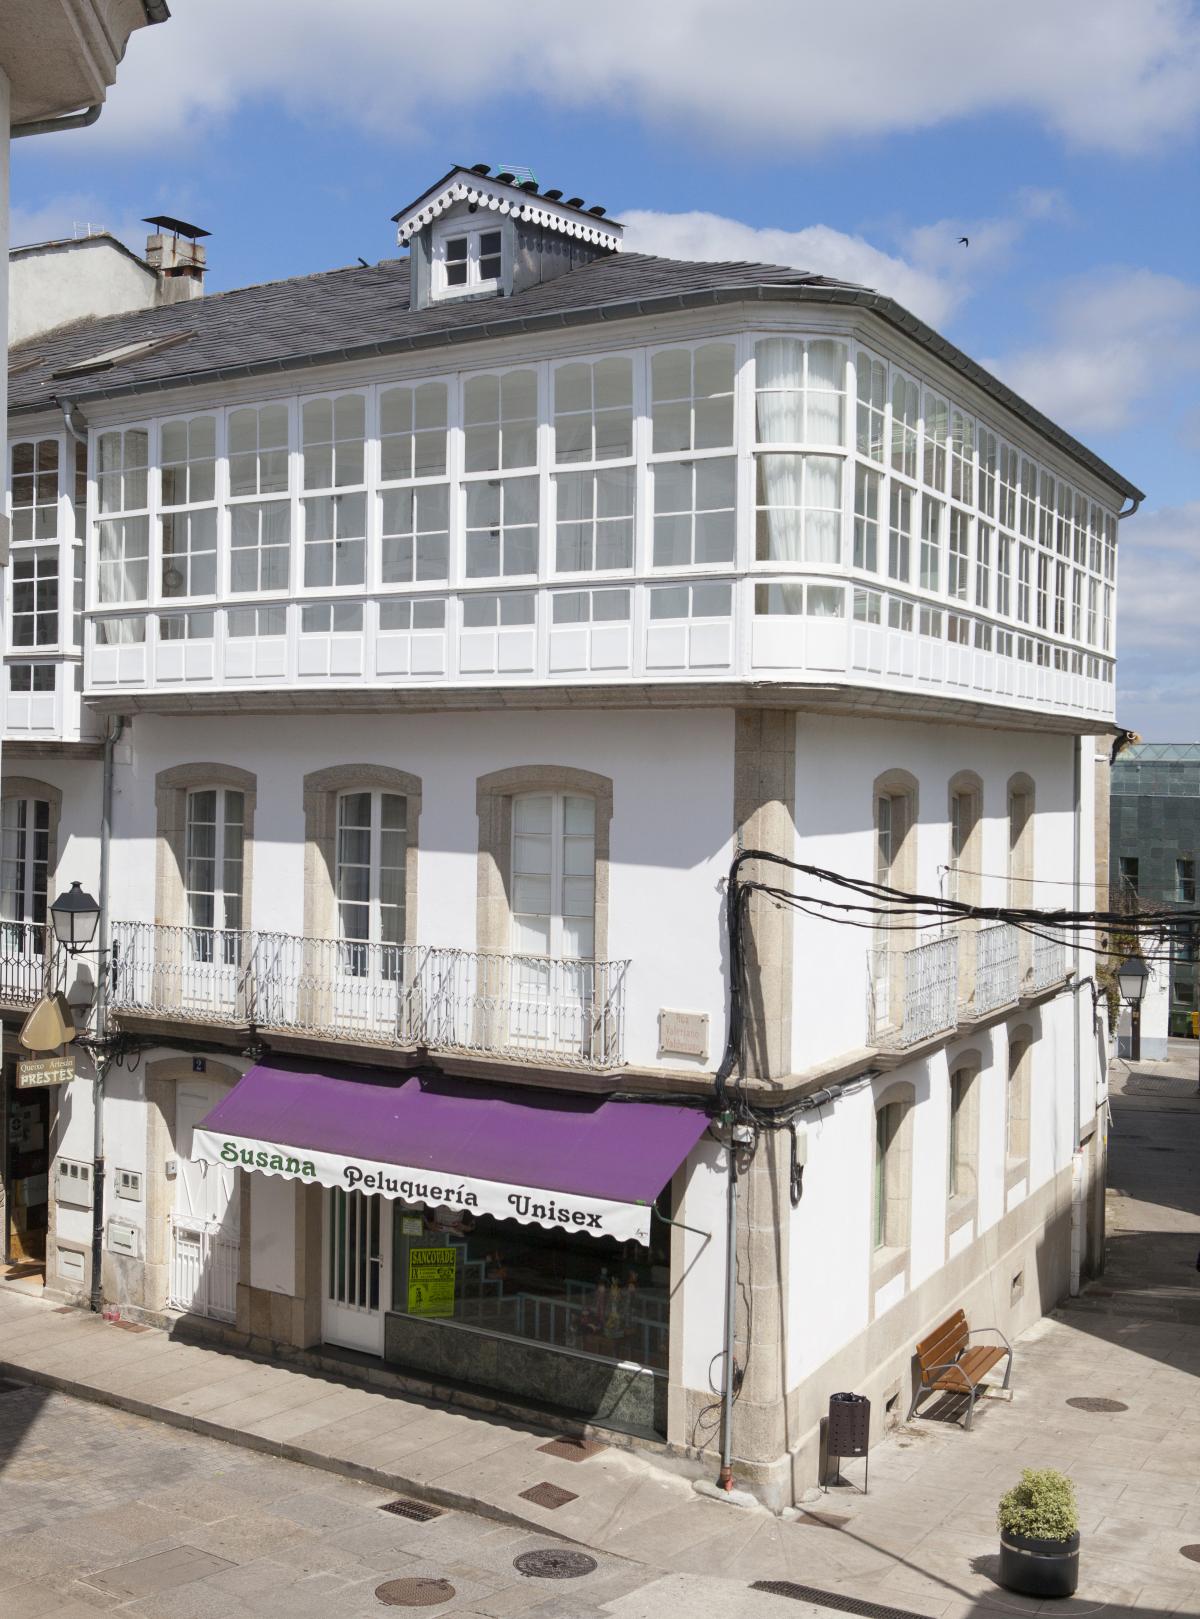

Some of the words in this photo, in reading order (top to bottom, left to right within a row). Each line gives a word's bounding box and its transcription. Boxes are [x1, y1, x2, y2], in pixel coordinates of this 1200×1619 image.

[21, 1063, 45, 1072] Queixo
[21, 1068, 74, 1086] PRESTES
[220, 1142, 317, 1177] Susana
[343, 1165, 479, 1208] Peluquería
[507, 1193, 604, 1229] Unisex
